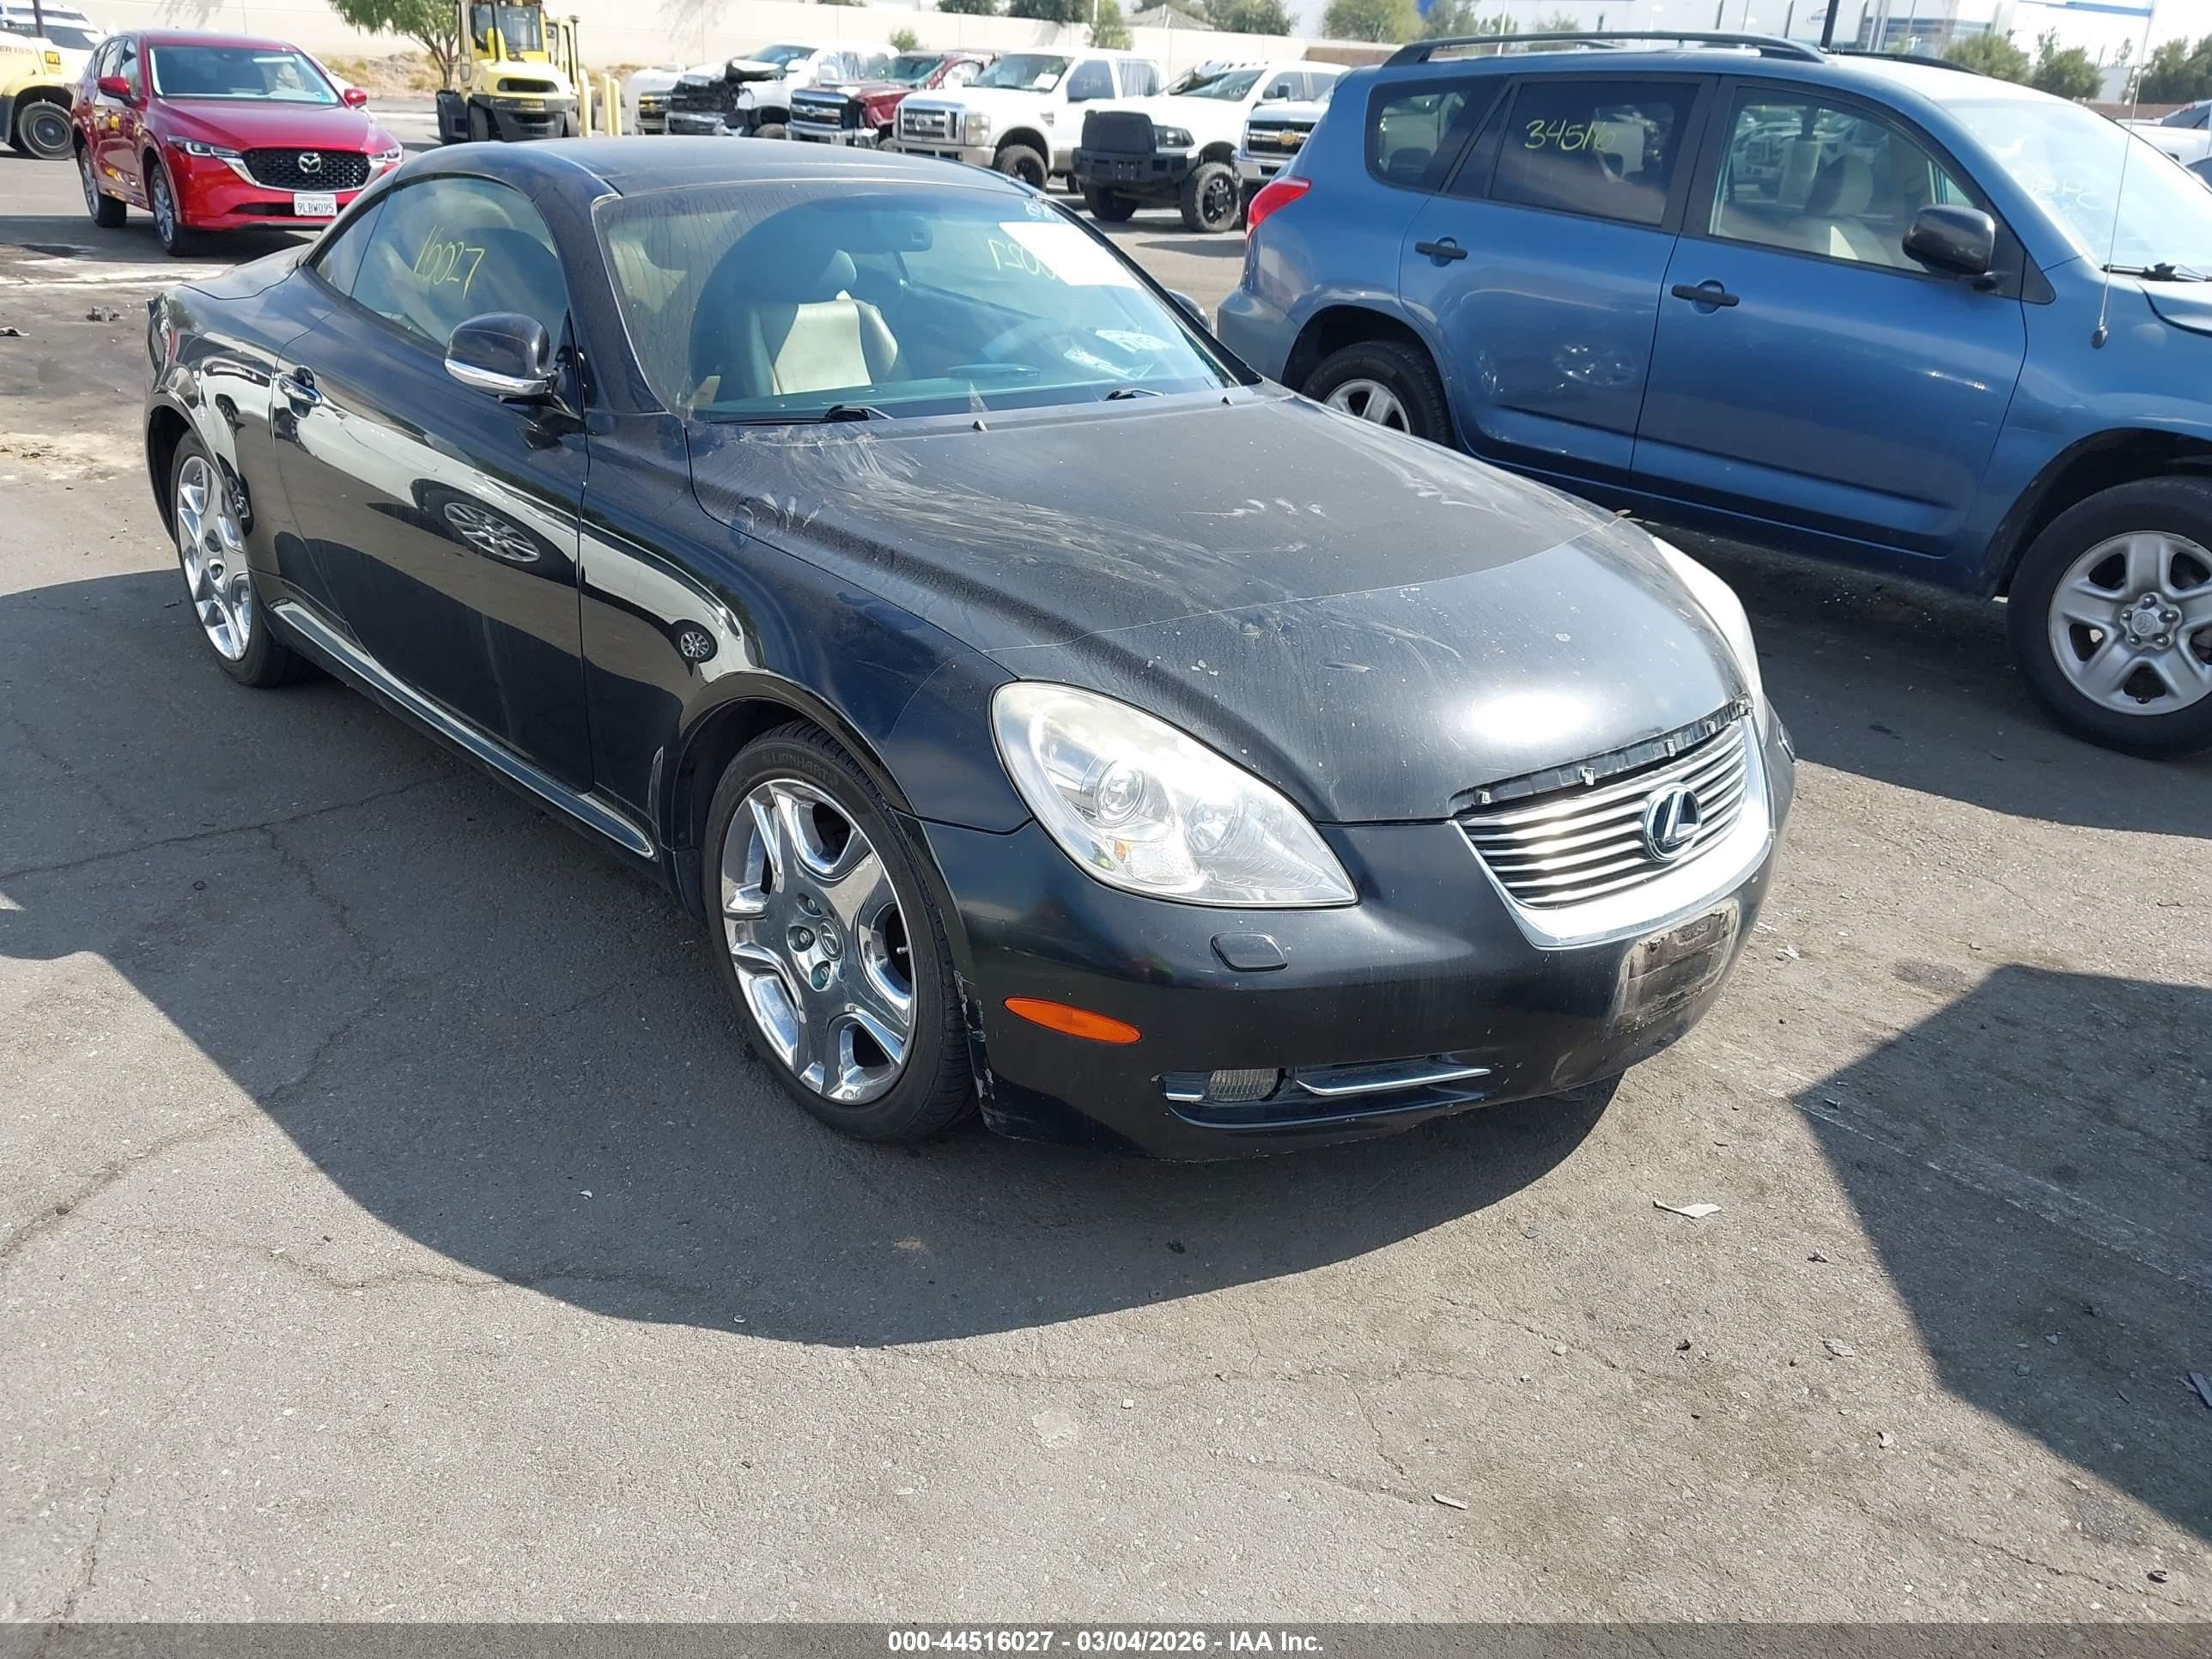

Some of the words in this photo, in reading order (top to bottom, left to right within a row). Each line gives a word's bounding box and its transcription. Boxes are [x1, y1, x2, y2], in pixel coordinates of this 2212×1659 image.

[1525, 119, 1616, 151] 34516
[414, 224, 486, 301] 16027
[772, 752, 830, 781] LIONHART
